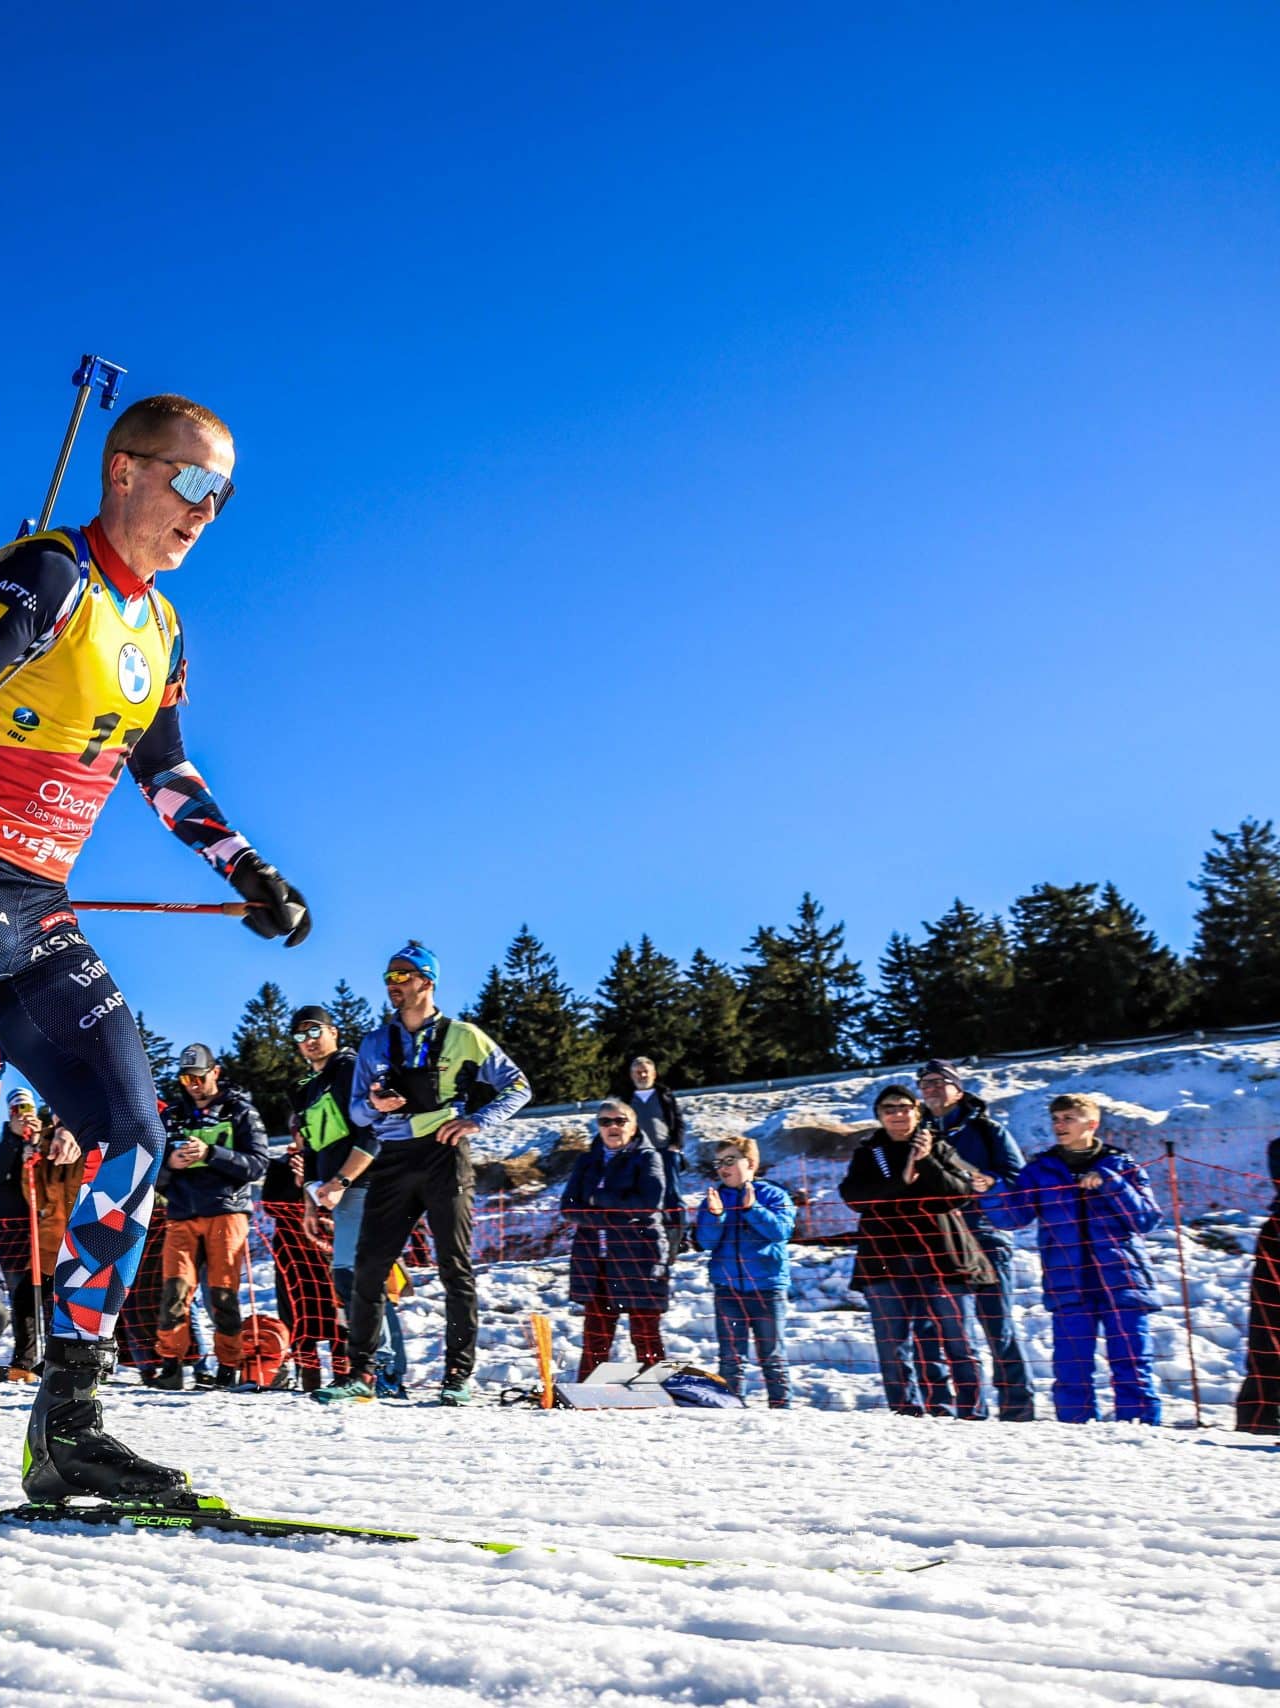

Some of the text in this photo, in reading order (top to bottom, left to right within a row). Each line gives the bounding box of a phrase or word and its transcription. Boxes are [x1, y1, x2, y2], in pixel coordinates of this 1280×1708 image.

[7, 730, 26, 743] IBU
[40, 780, 101, 819] Oberh
[25, 801, 49, 822] Das
